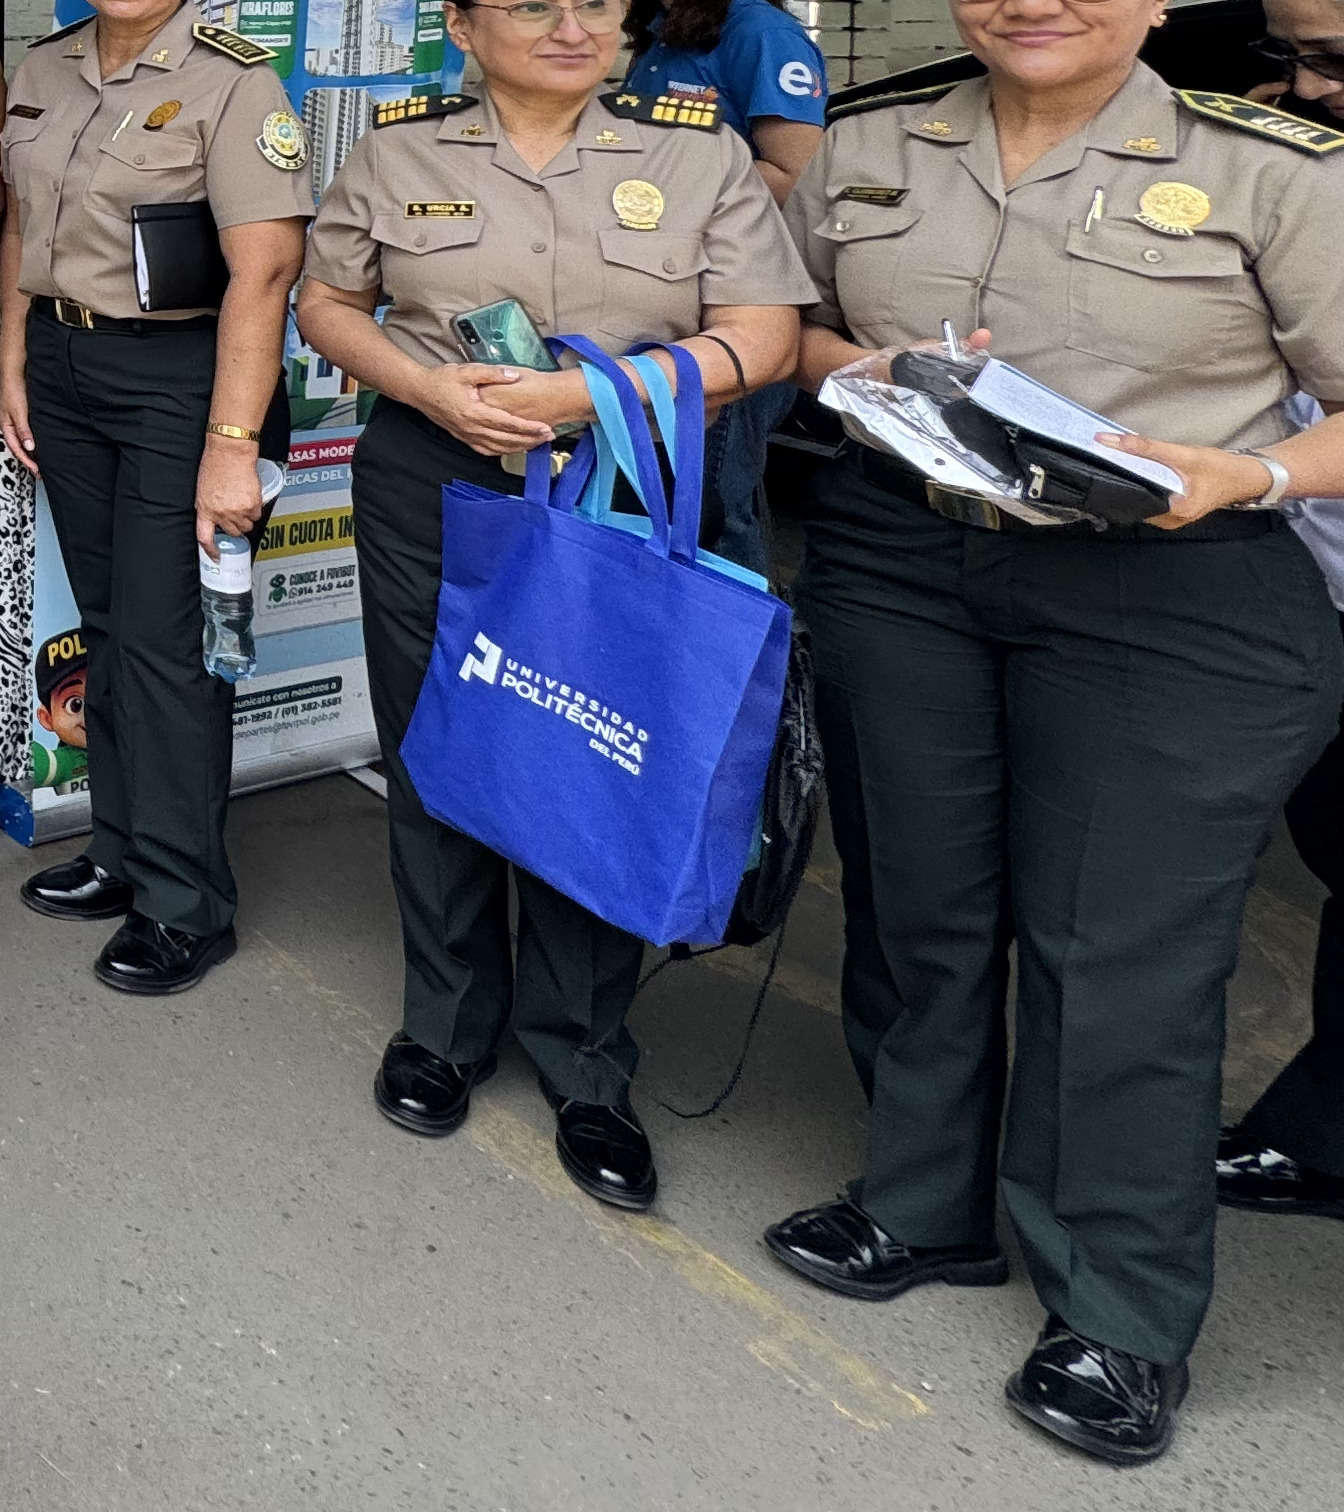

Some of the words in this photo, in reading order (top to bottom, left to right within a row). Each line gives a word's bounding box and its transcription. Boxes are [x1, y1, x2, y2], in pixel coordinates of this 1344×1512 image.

[288, 448, 317, 463] ASAS
[318, 444, 355, 460] MODE
[321, 468, 344, 482] DEL
[261, 524, 286, 551] SIN
[289, 517, 334, 546] CUOTA
[319, 569, 325, 581] A
[316, 582, 333, 593] 249
[47, 633, 87, 667] POL
[506, 657, 648, 742] UNIVERSIDAD
[501, 672, 643, 763] POLITÉCNICA
[588, 738, 610, 759] DEL
